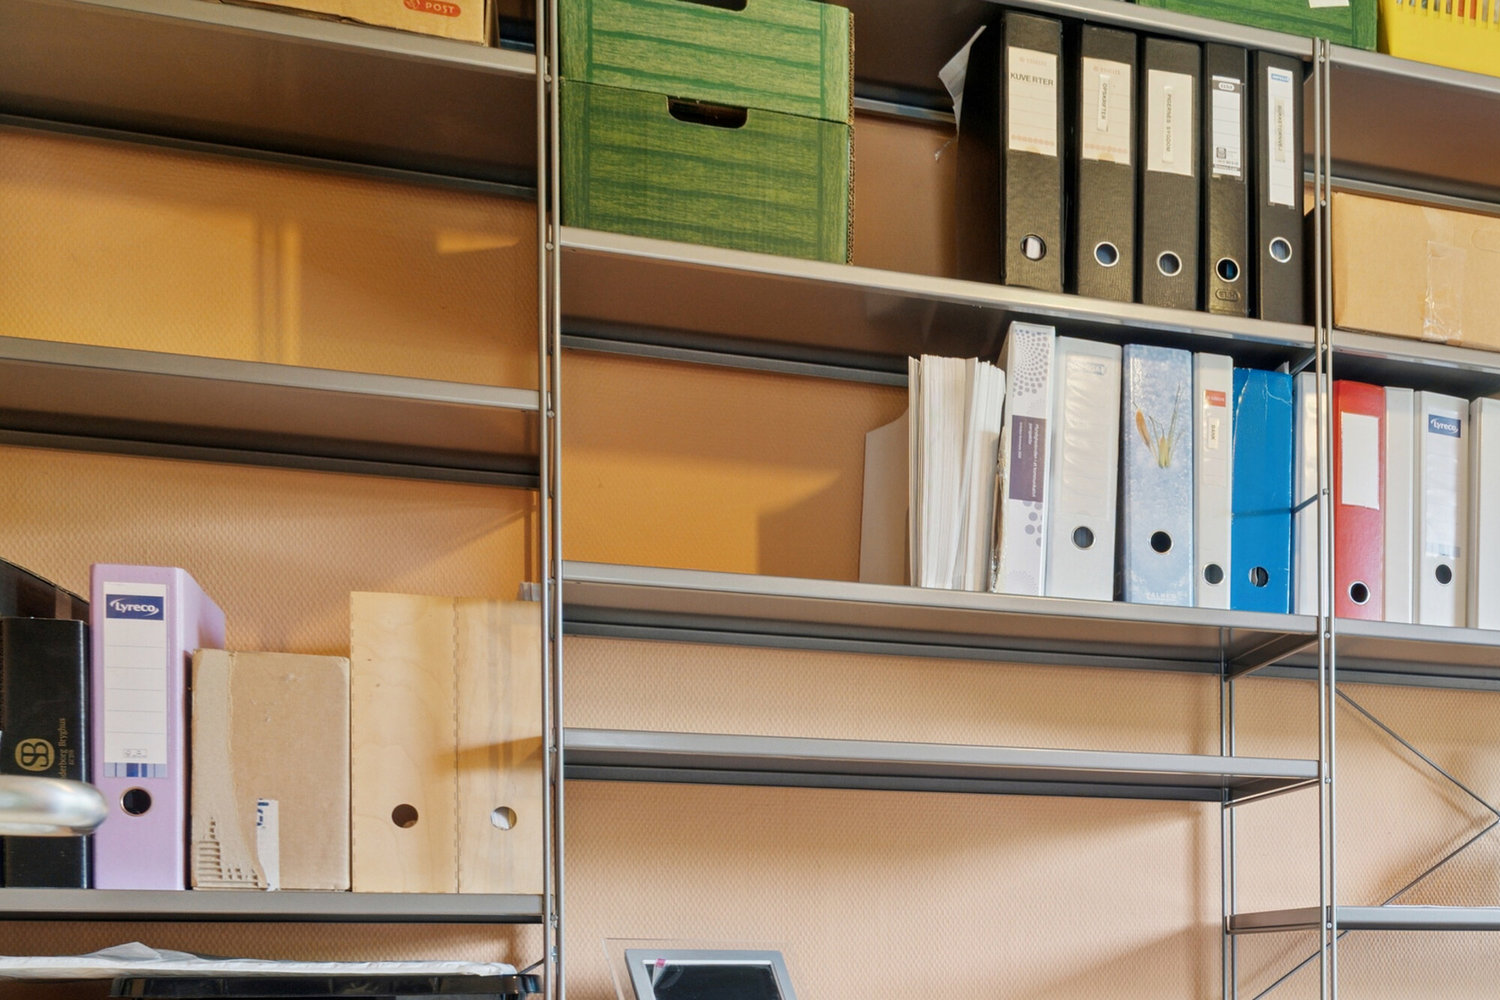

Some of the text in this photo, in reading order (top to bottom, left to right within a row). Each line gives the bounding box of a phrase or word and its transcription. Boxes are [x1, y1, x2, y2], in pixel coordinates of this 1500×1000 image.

[426, 2, 455, 14] POST
[1433, 420, 1457, 430] Lyreco
[114, 601, 156, 614] Lyreco
